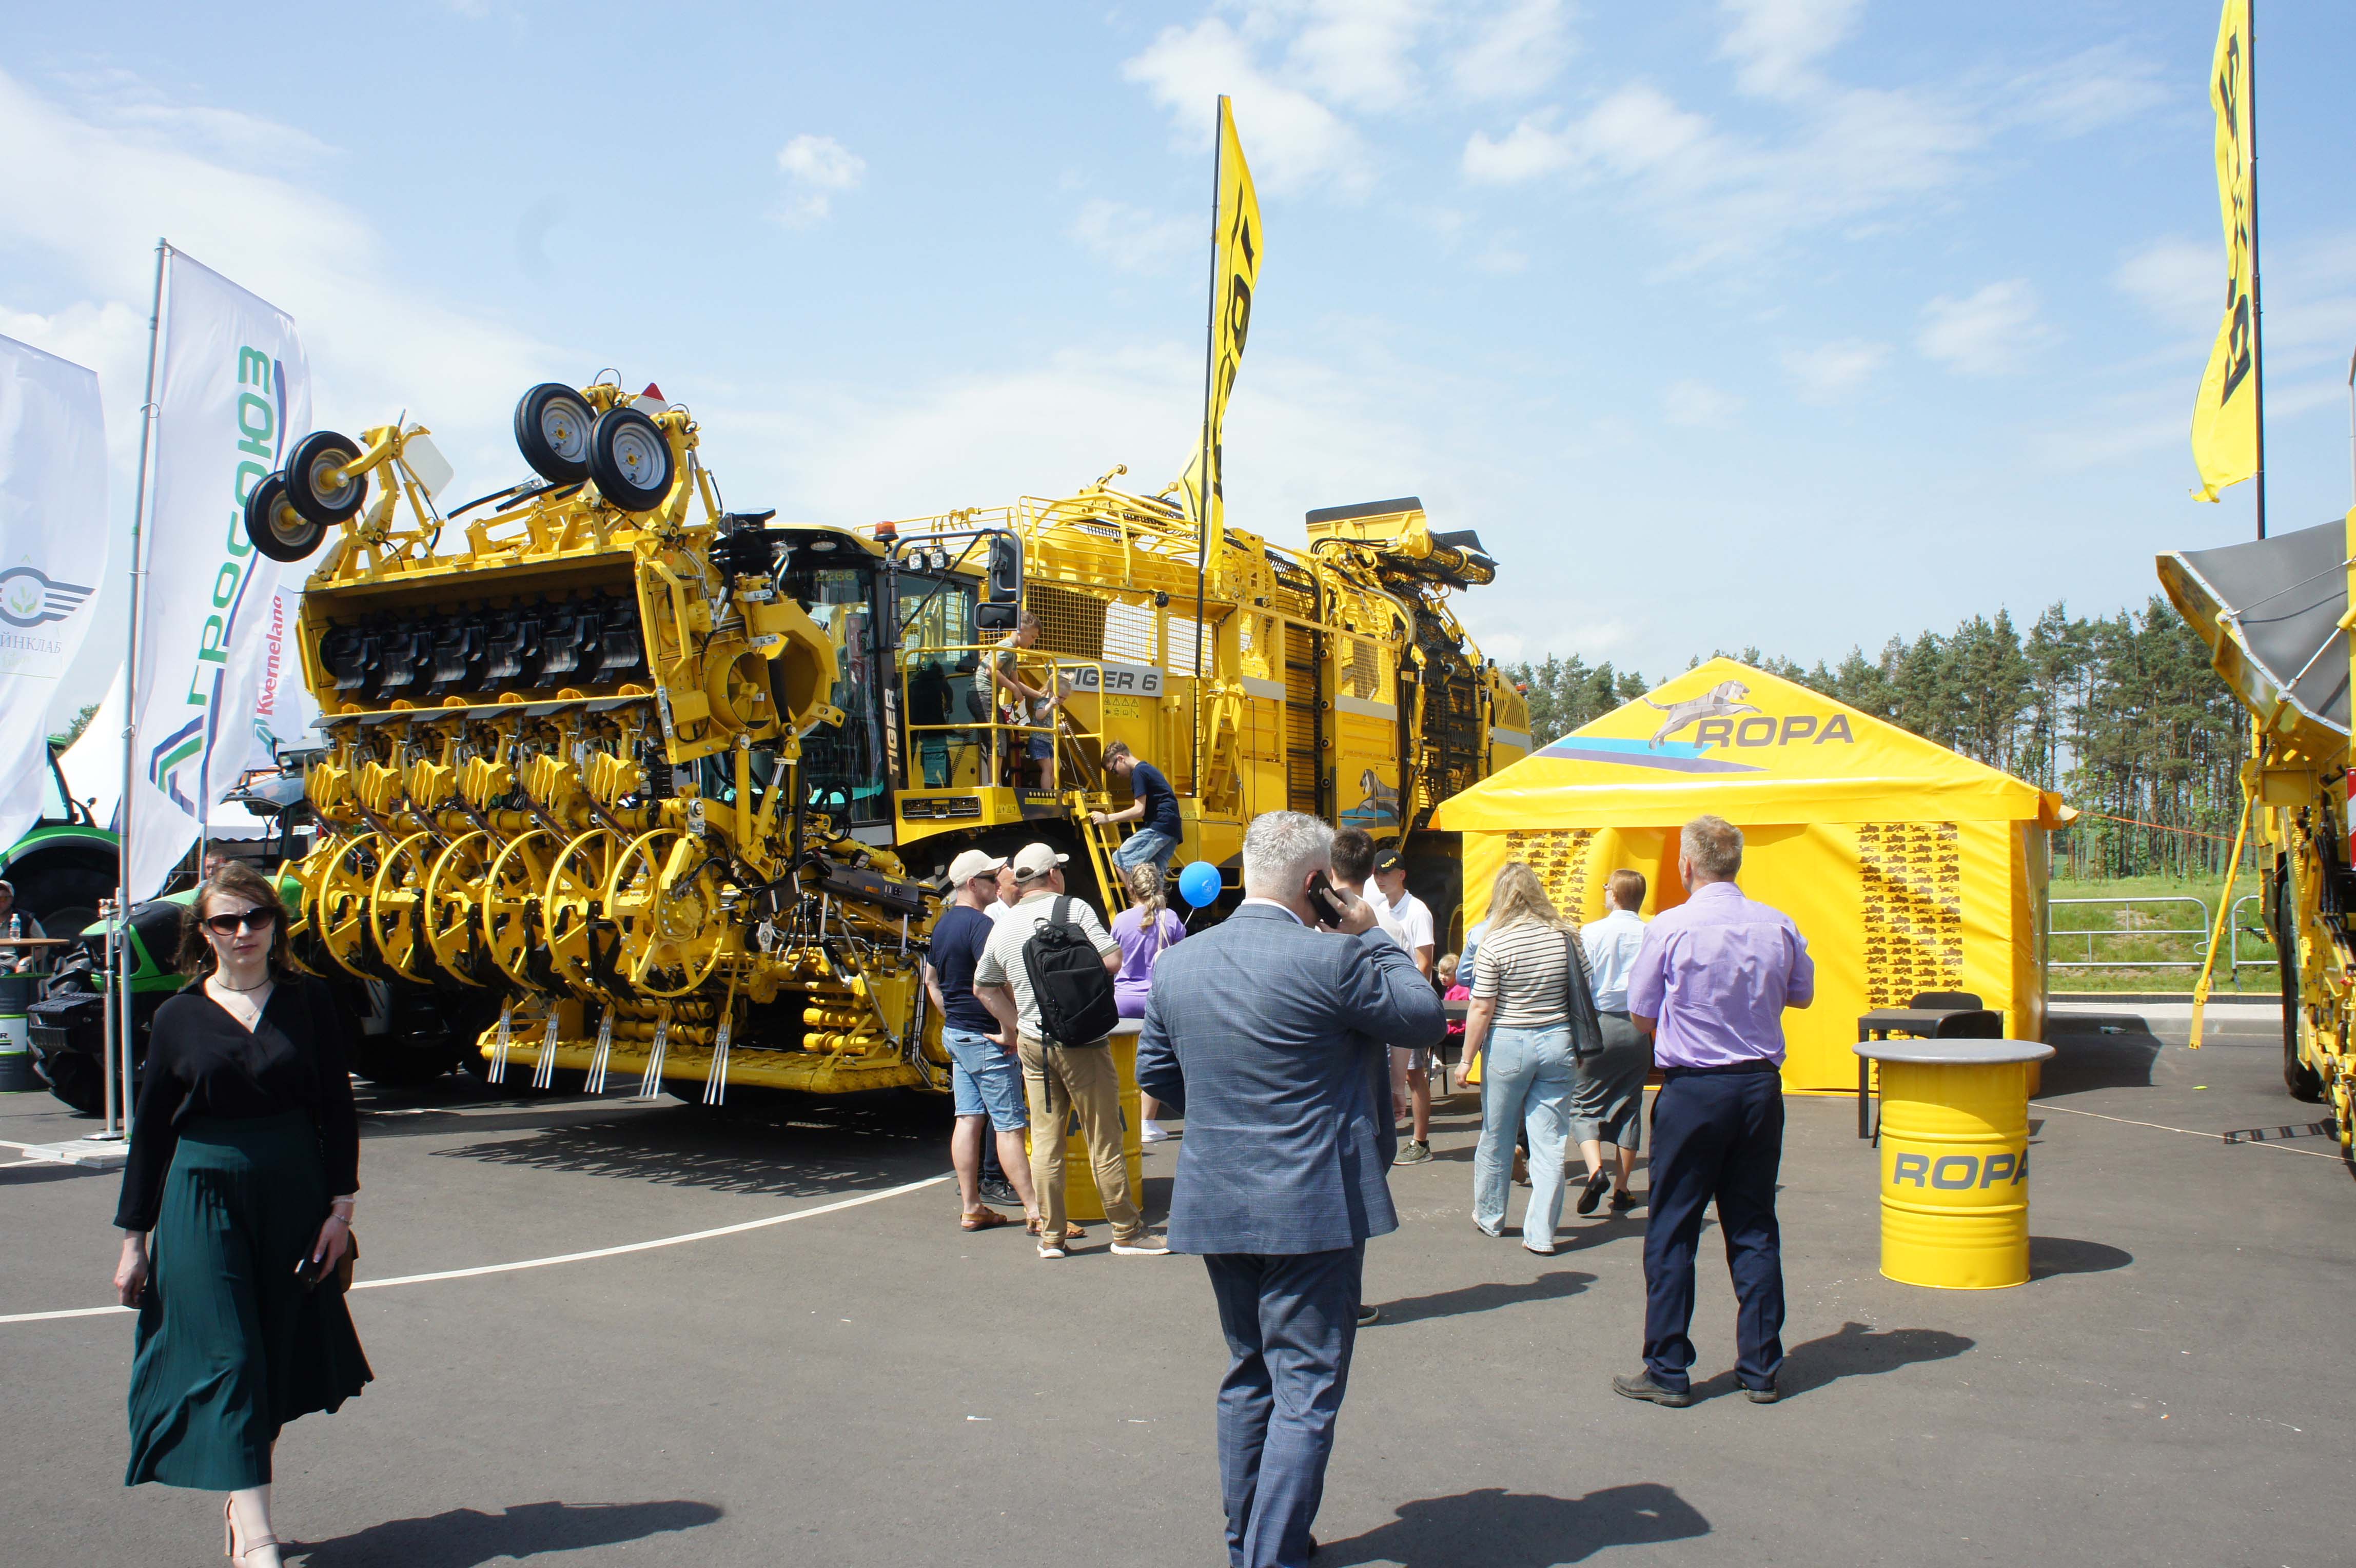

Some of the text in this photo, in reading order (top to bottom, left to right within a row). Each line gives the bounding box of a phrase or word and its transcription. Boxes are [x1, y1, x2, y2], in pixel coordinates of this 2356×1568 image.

[1142, 674, 1157, 691] 6
[885, 688, 899, 775] TIGER
[1693, 714, 1854, 749] ROPA
